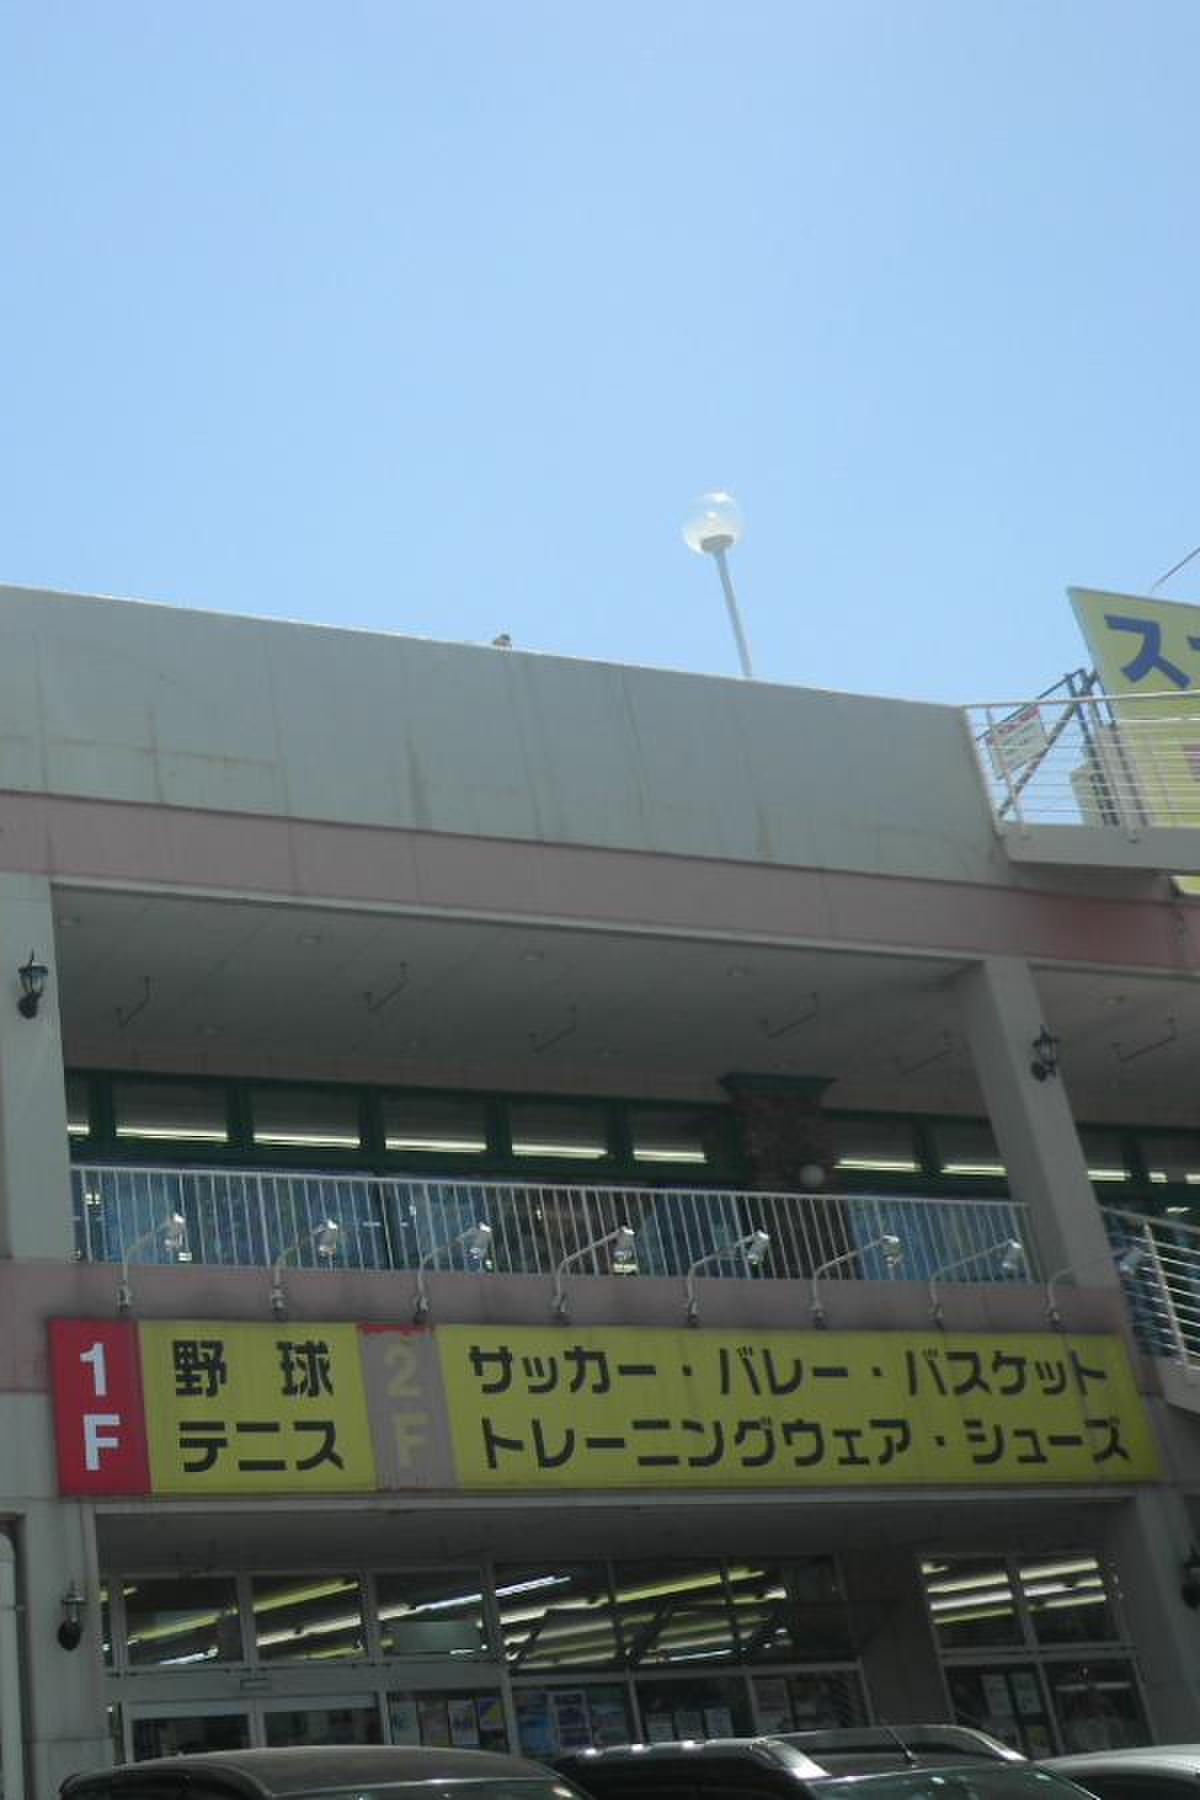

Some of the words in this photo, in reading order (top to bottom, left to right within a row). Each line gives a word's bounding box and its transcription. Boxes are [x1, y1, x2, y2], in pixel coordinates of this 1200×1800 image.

[1104, 613, 1200, 688] ス
[178, 1421, 344, 1472] テニス
